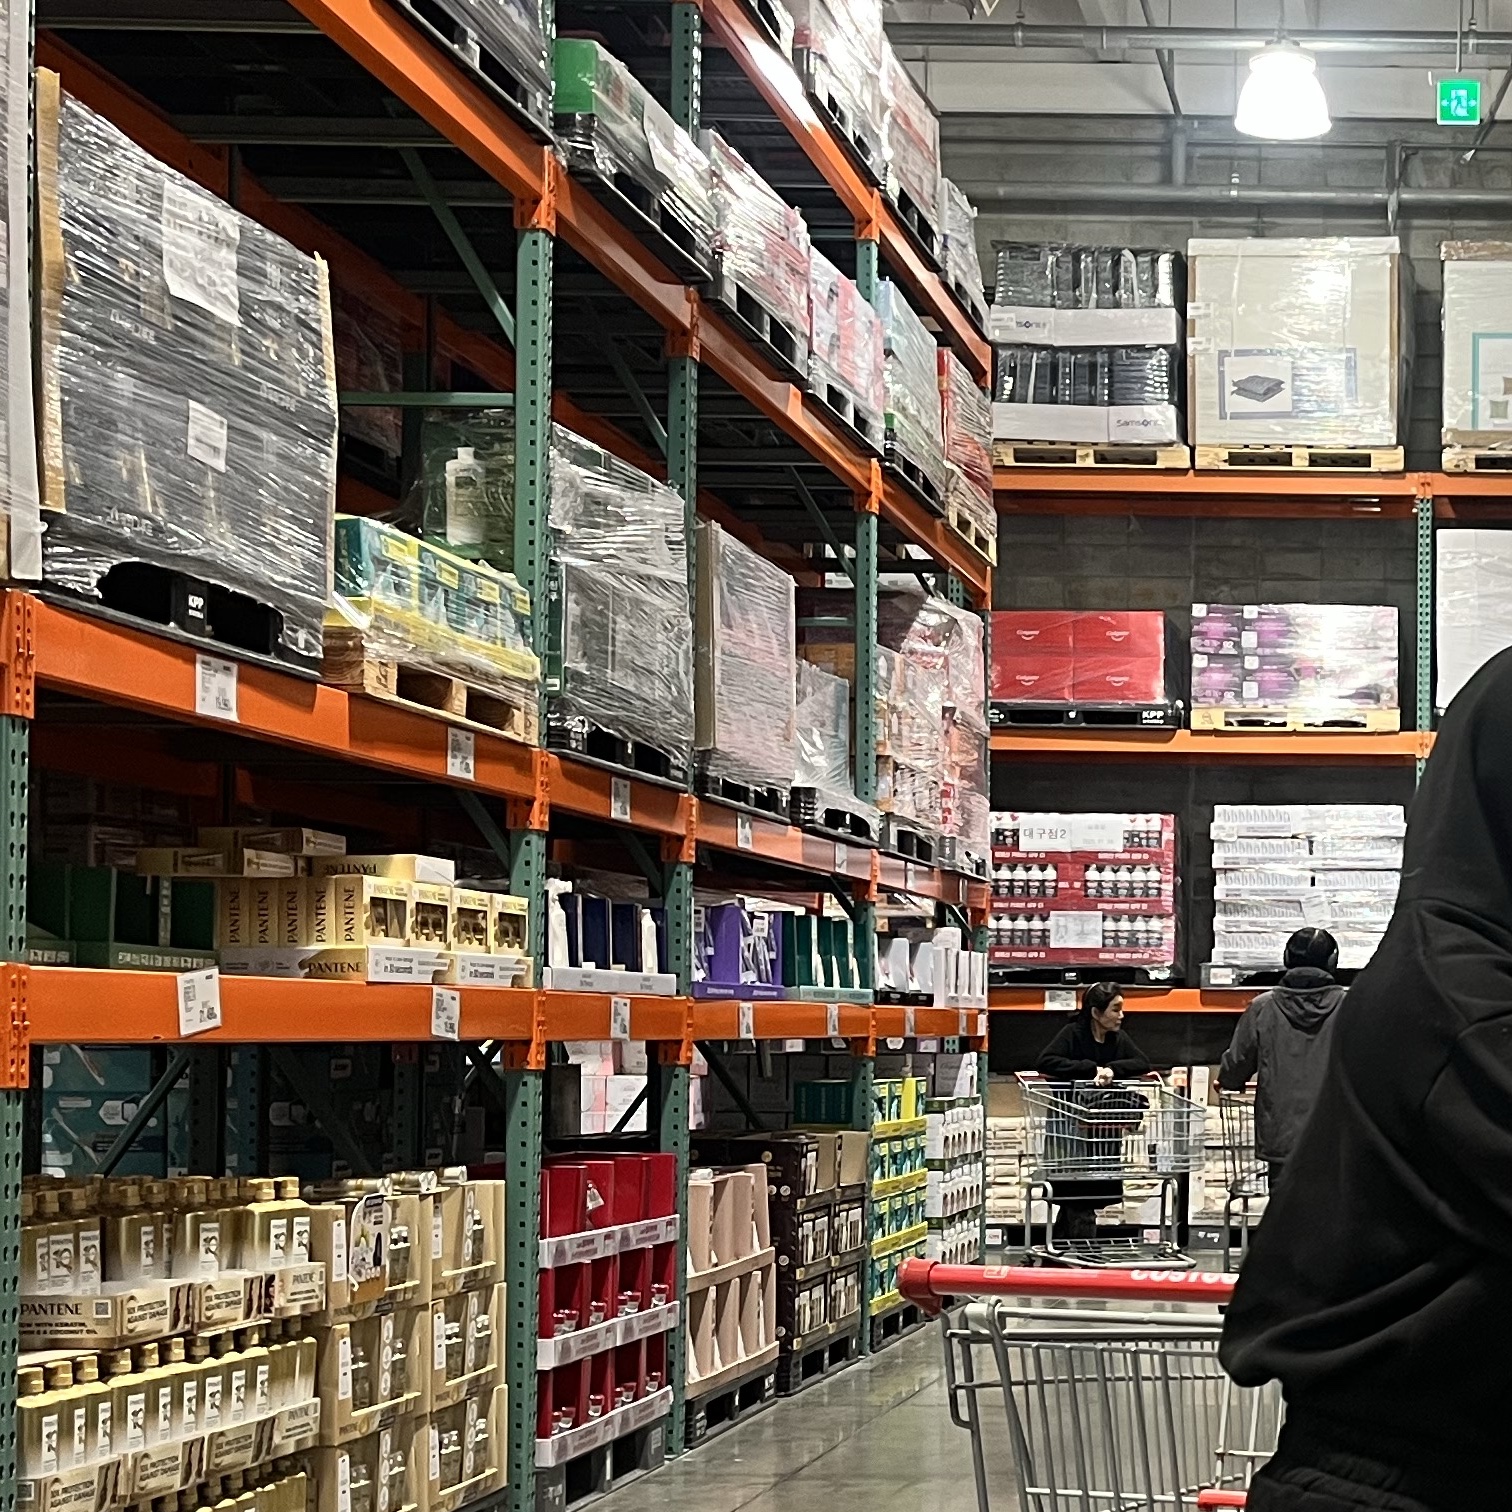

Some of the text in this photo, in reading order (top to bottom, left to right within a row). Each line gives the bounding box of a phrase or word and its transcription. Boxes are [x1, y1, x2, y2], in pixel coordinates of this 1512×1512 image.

[1142, 711, 1165, 719] KPP
[229, 885, 241, 944] PANTENE
[258, 889, 270, 944] PANTENE
[288, 889, 299, 944] PANTENE
[315, 886, 327, 942] PANTENE
[345, 885, 356, 942] PANTENE
[308, 961, 362, 974] PANTENE
[20, 1303, 82, 1317] PANTENE
